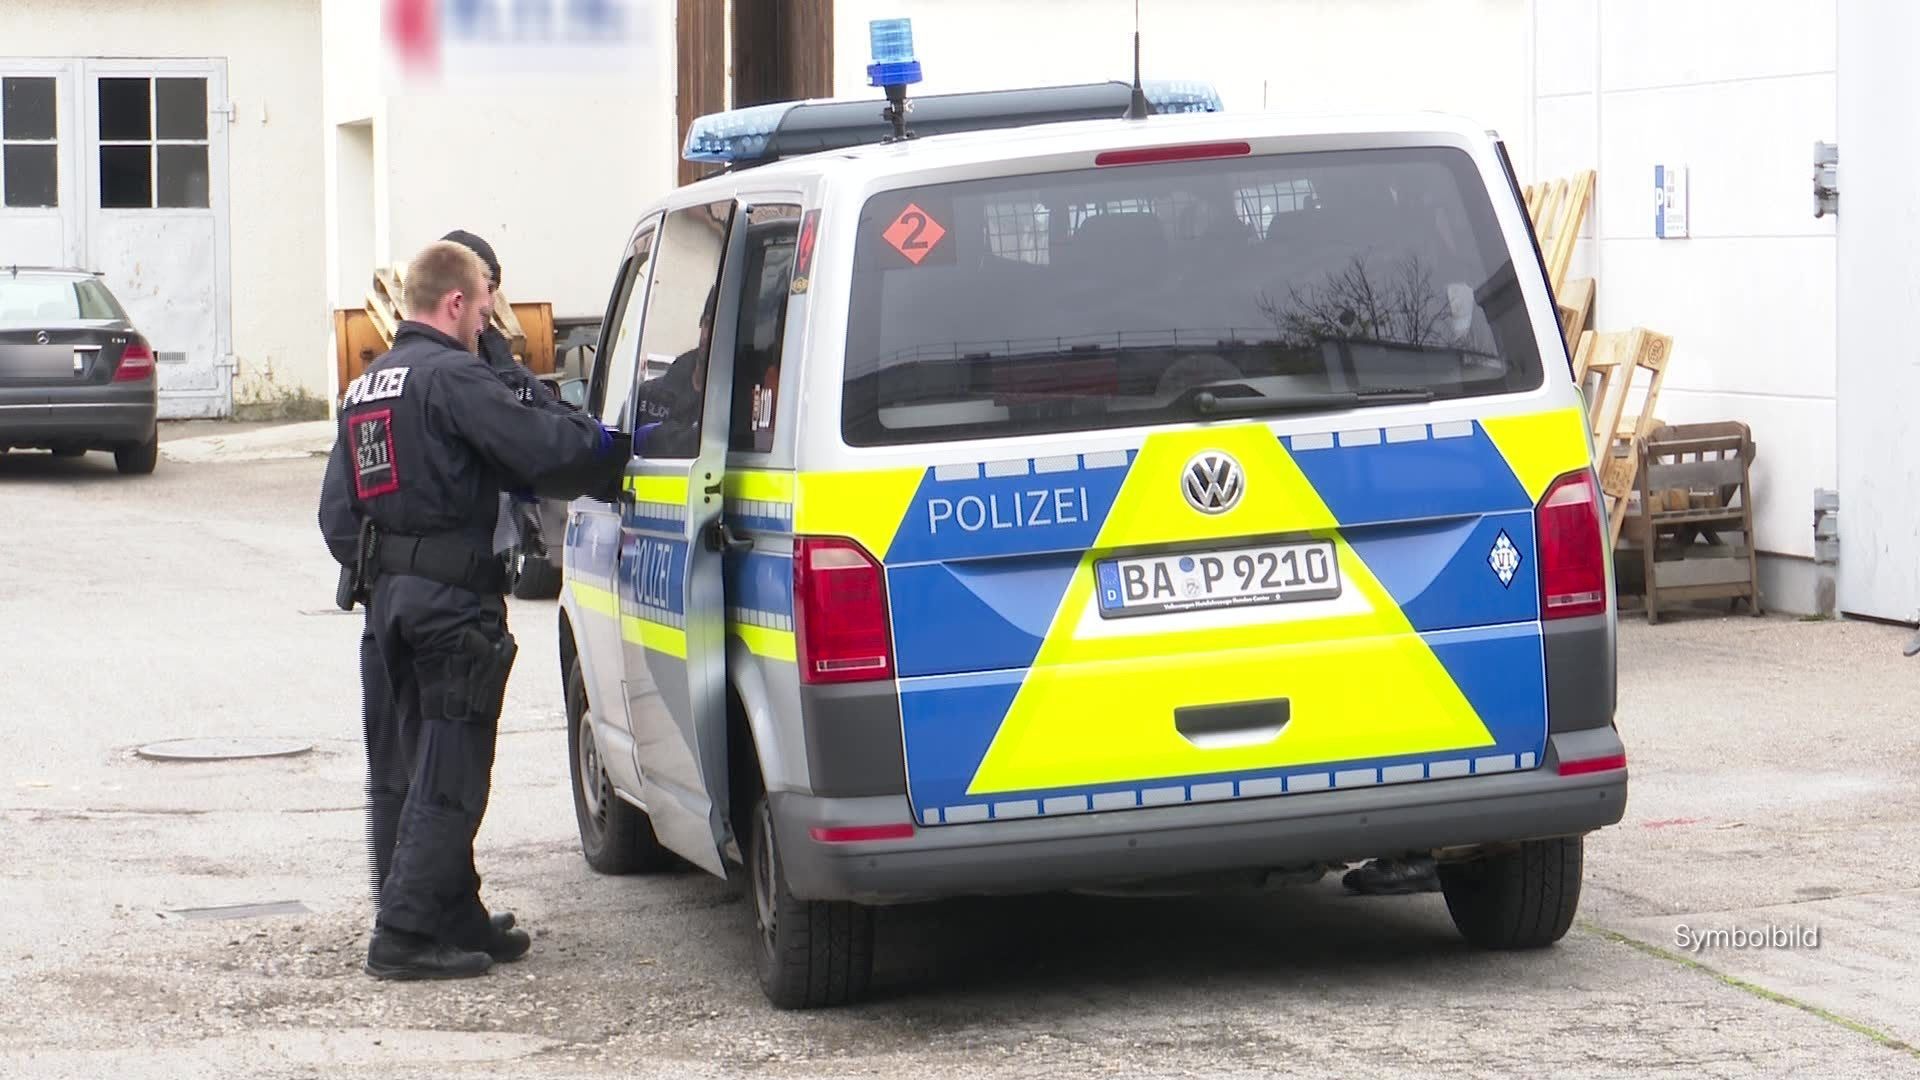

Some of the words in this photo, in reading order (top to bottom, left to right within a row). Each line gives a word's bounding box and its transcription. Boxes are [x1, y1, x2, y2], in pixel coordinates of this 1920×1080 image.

[1656, 187, 1664, 216] P
[900, 211, 928, 250] 2
[342, 367, 410, 410] POLIZEI
[361, 420, 377, 444] BY
[357, 441, 388, 468] 6211
[1184, 453, 1241, 512] VW
[928, 487, 1088, 533] POLIZEI
[631, 538, 673, 609] POLIZEI
[1123, 562, 1176, 601] BA
[1200, 557, 1224, 593] P
[1233, 548, 1329, 591] 9210
[1107, 590, 1117, 600] D
